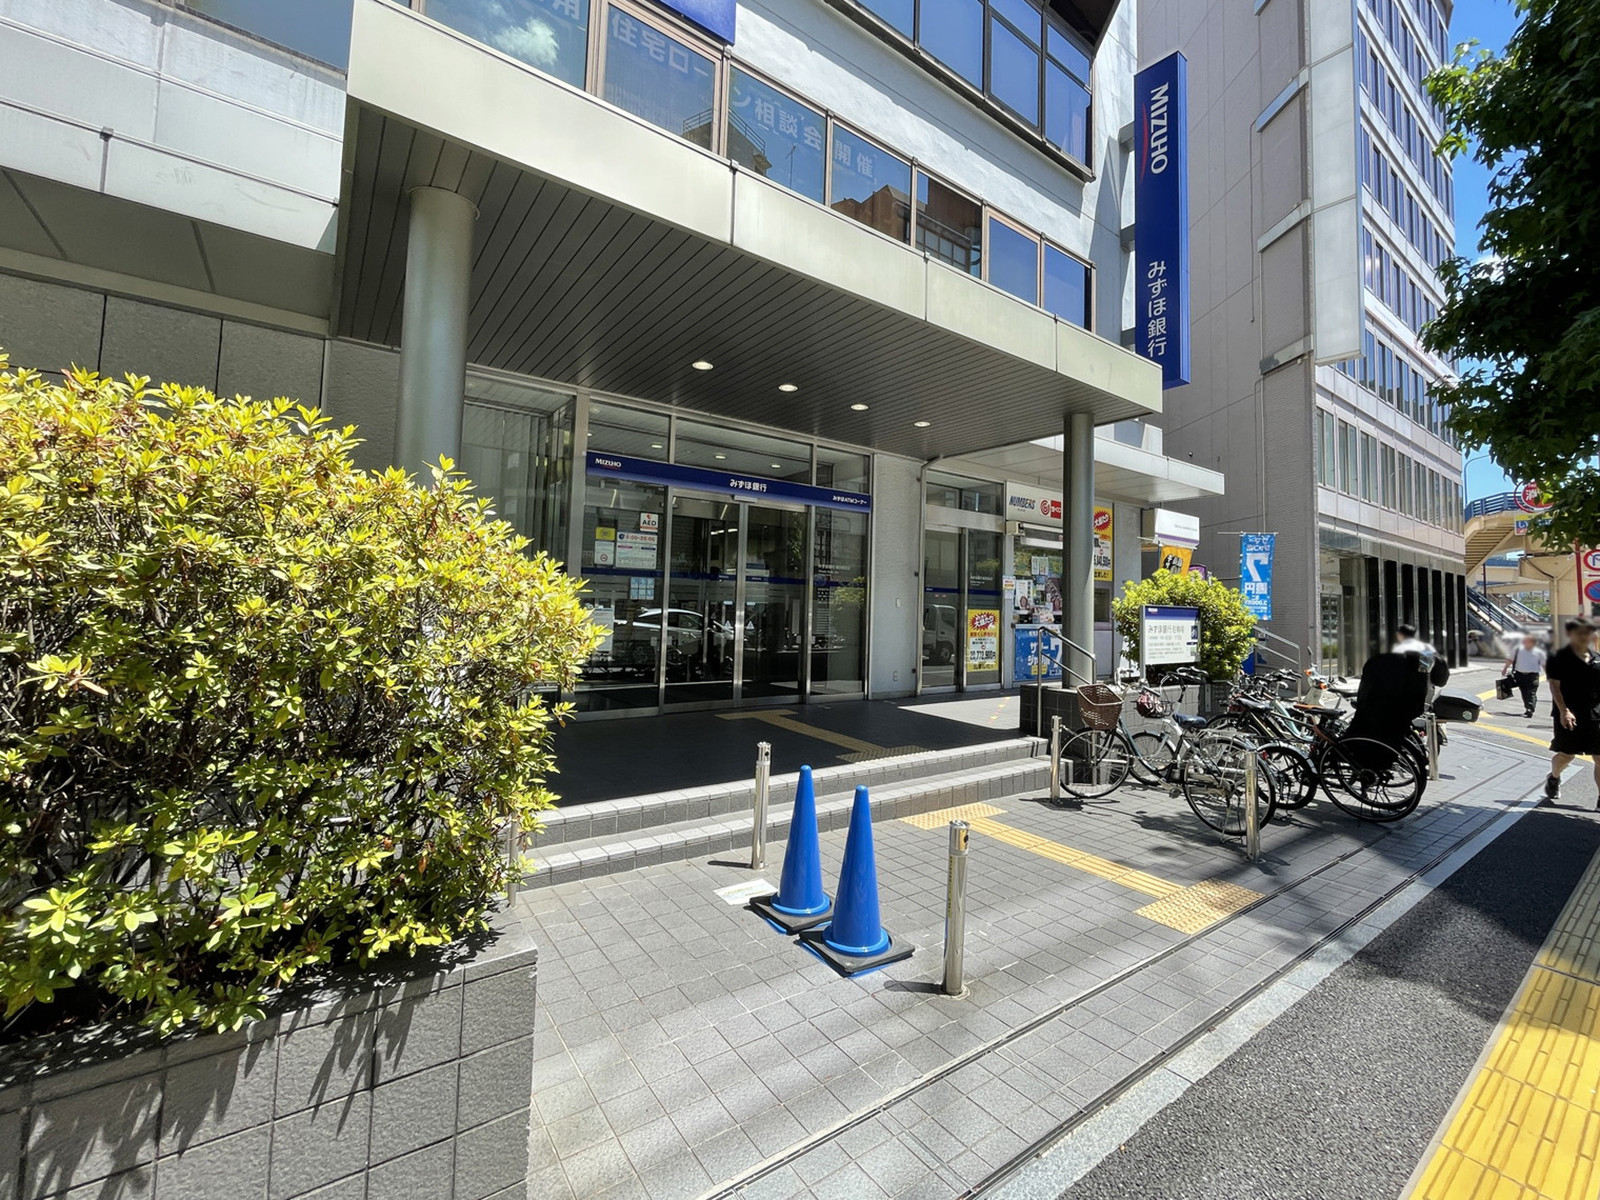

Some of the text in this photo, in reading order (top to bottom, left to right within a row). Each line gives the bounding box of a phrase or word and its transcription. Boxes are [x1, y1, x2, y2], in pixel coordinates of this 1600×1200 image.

[1150, 82, 1169, 174] MIZUHO
[1147, 260, 1168, 358] みずほ銀行
[595, 457, 622, 469] MIZUHO
[729, 478, 768, 493] みずほ銀行
[1009, 495, 1036, 510] NUMBERS
[1030, 641, 1049, 654] サー
